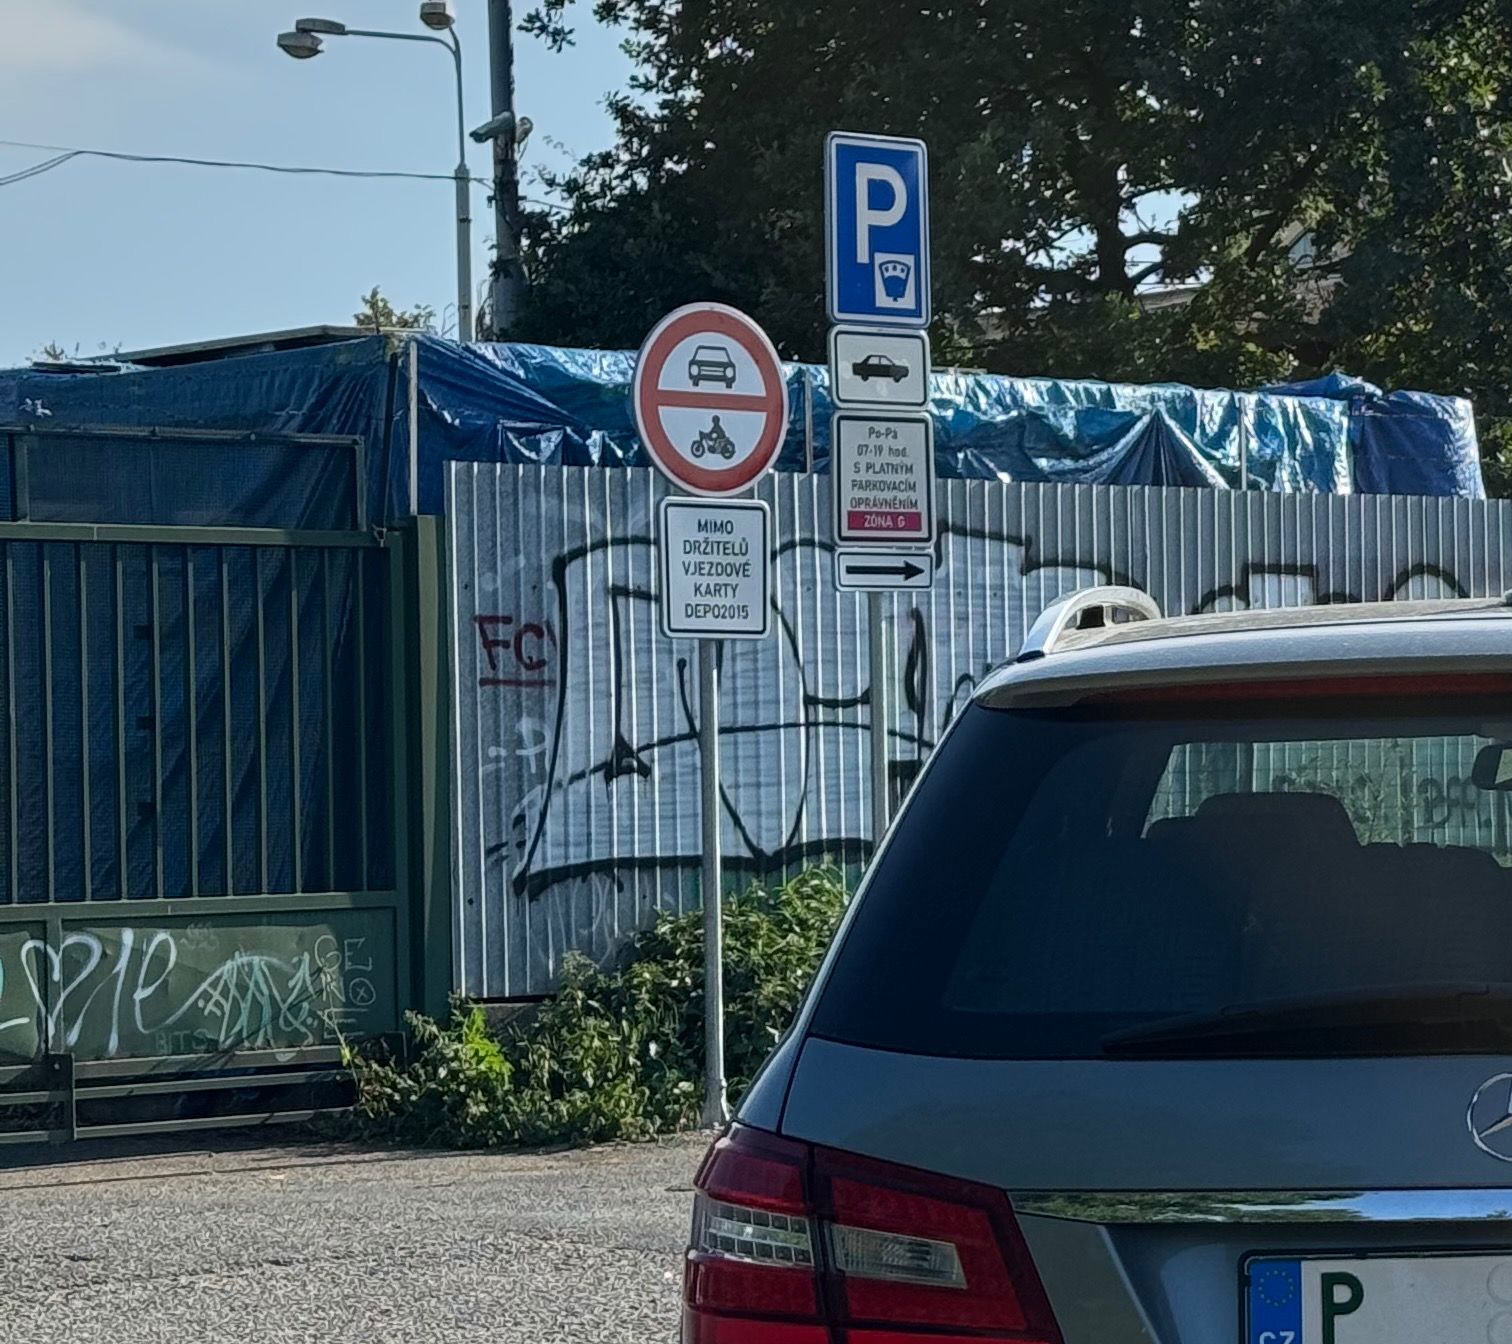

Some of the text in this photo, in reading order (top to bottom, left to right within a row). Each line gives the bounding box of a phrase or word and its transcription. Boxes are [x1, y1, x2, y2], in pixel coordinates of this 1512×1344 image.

[855, 162, 908, 264] P
[868, 425, 898, 440] Po-Pá
[857, 444, 884, 457] 07-19
[853, 460, 914, 475] S PLATNÝM
[851, 478, 917, 493] PARKOVACÍM
[850, 495, 918, 511] OPRÁVNĚNÍM
[697, 519, 734, 535] MIMO
[864, 514, 893, 528] ZÓNA
[683, 537, 749, 557] DRŽITELŮ
[681, 559, 751, 578] VJEZDOVÉ
[694, 582, 739, 599] KARTY
[684, 603, 749, 619] DEPO2015
